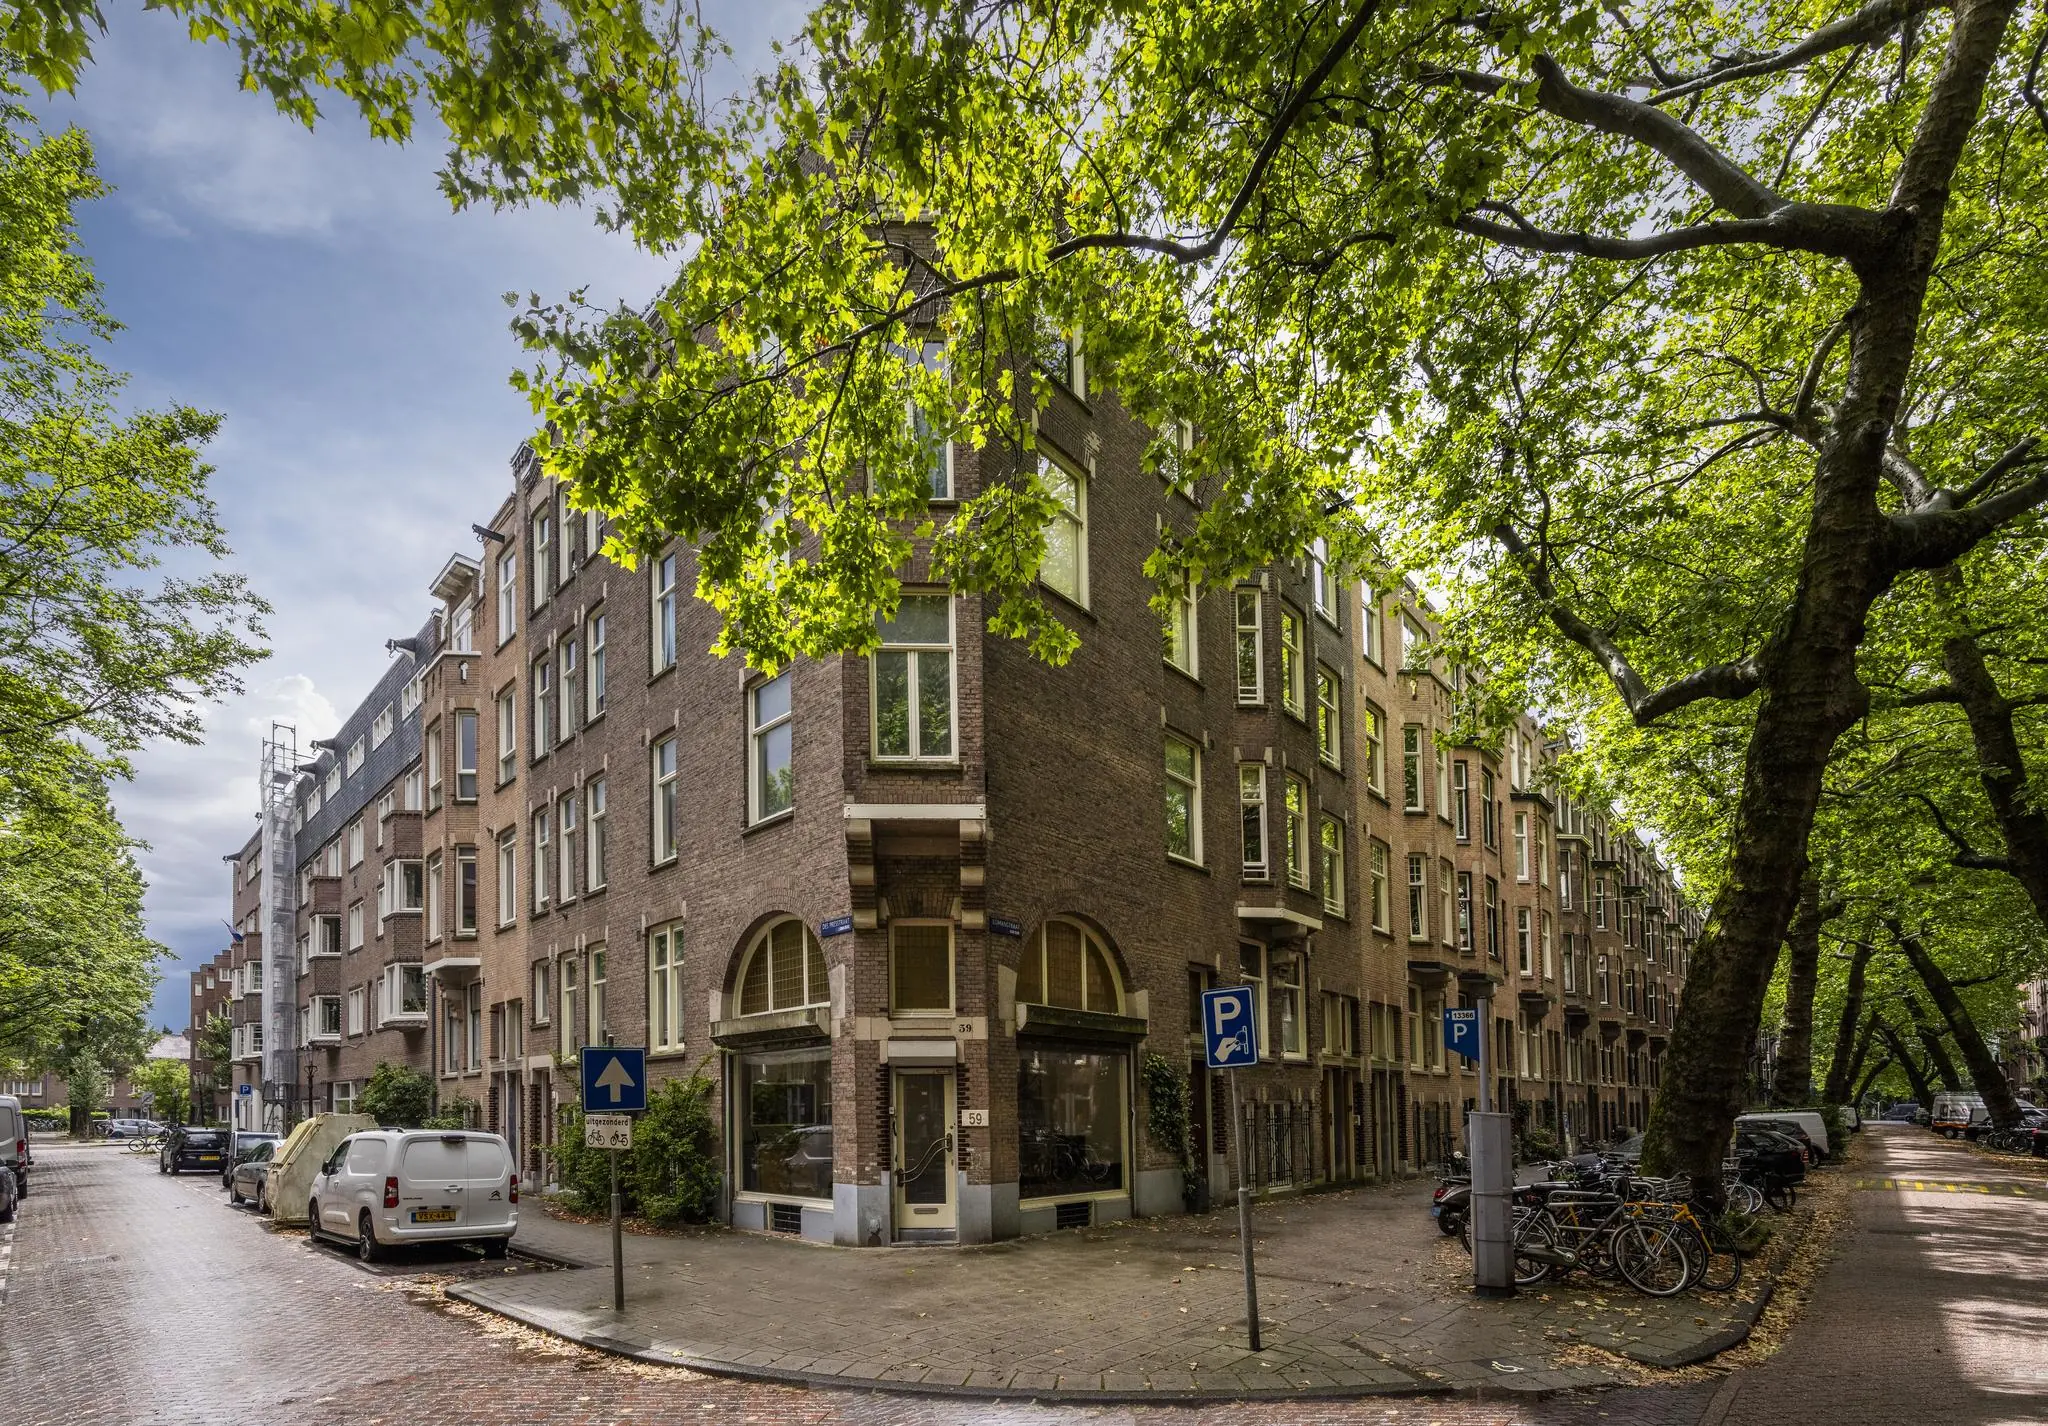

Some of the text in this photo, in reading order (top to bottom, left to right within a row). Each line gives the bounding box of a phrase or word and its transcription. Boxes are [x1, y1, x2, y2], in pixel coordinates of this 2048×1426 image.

[1213, 995, 1242, 1035] P
[958, 1023, 972, 1033] 59
[1453, 1023, 1468, 1044] P
[242, 1085, 250, 1094] P
[585, 1117, 629, 1128] uitgezonderd
[968, 1112, 982, 1125] 59
